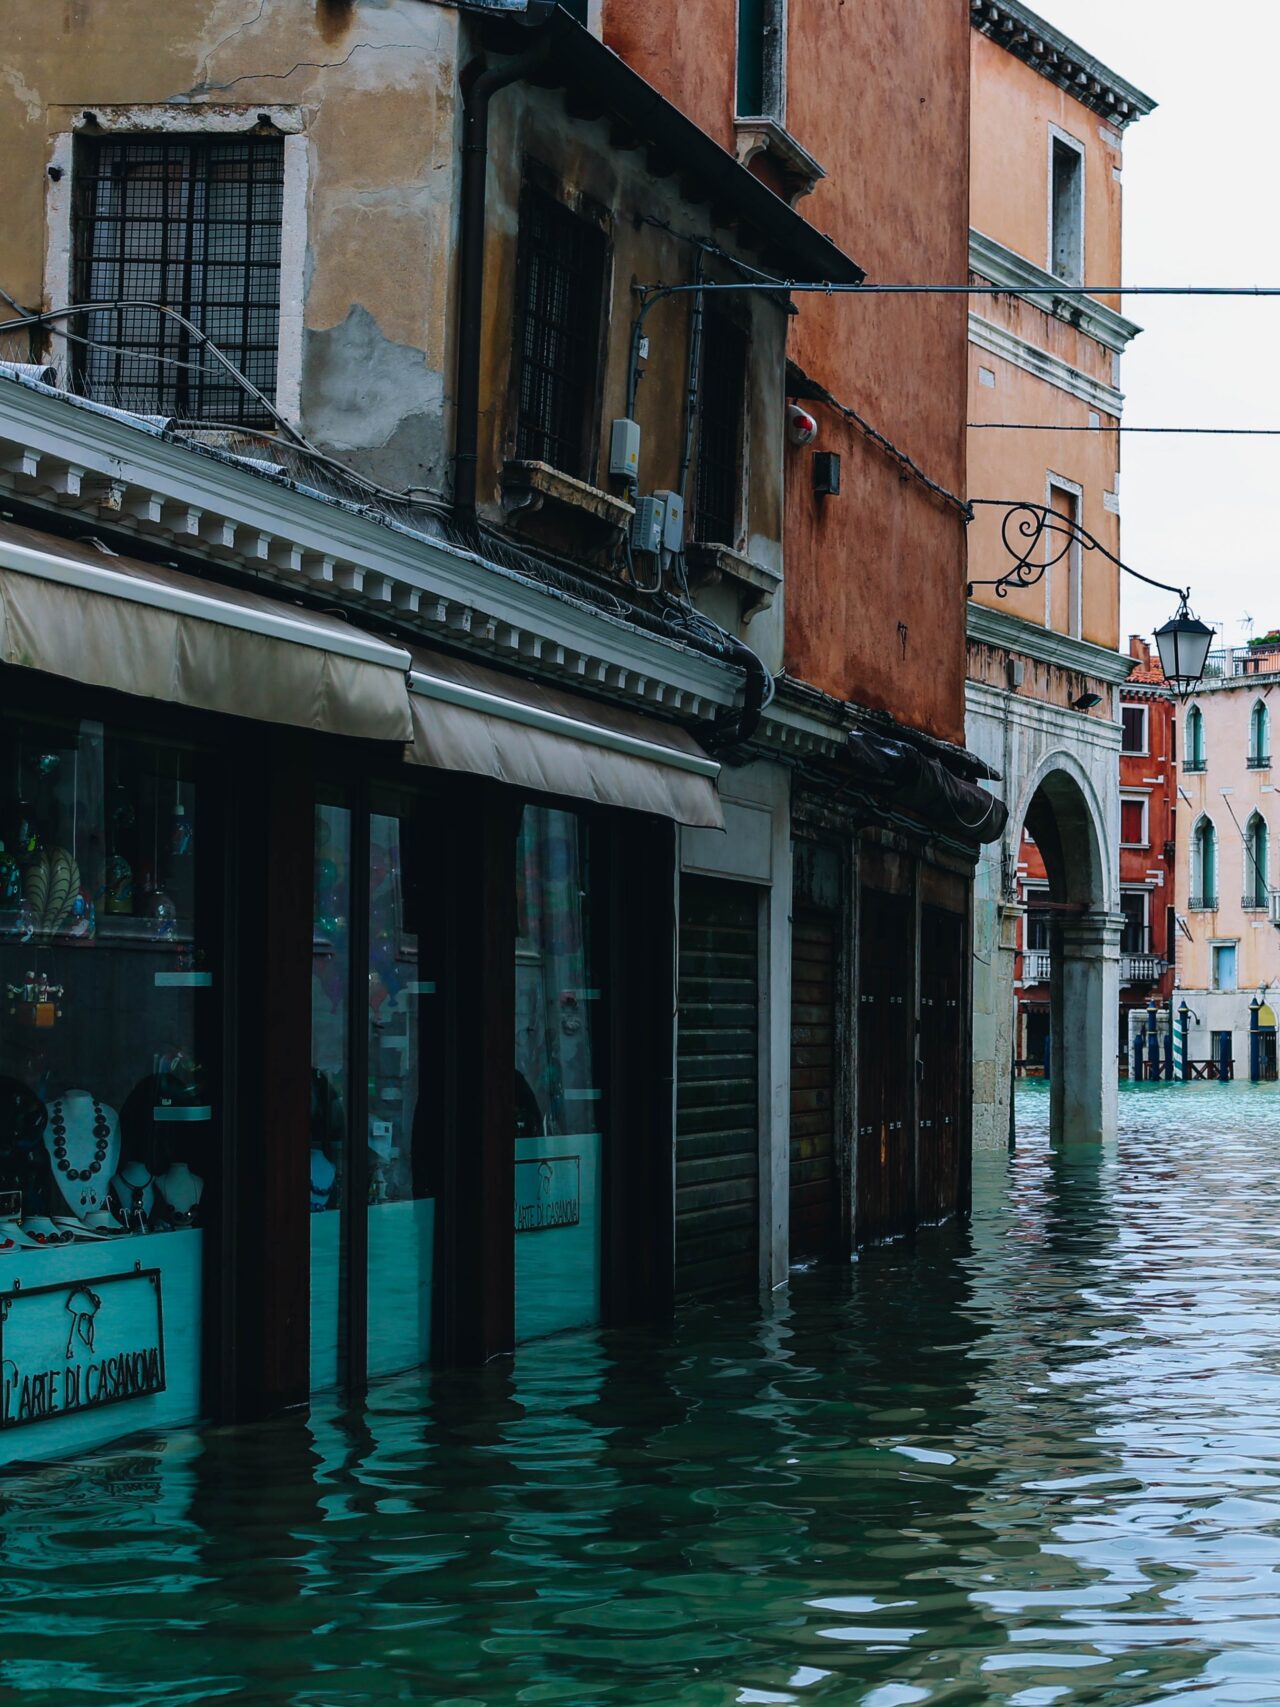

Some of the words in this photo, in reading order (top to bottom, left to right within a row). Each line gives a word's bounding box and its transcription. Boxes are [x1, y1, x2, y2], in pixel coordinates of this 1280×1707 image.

[536, 1203, 545, 1226] DI
[546, 1199, 578, 1225] CASANOVA
[3, 1360, 60, 1420] L'ARTE
[66, 1366, 81, 1409] DI
[86, 1348, 160, 1402] CASANOVA
